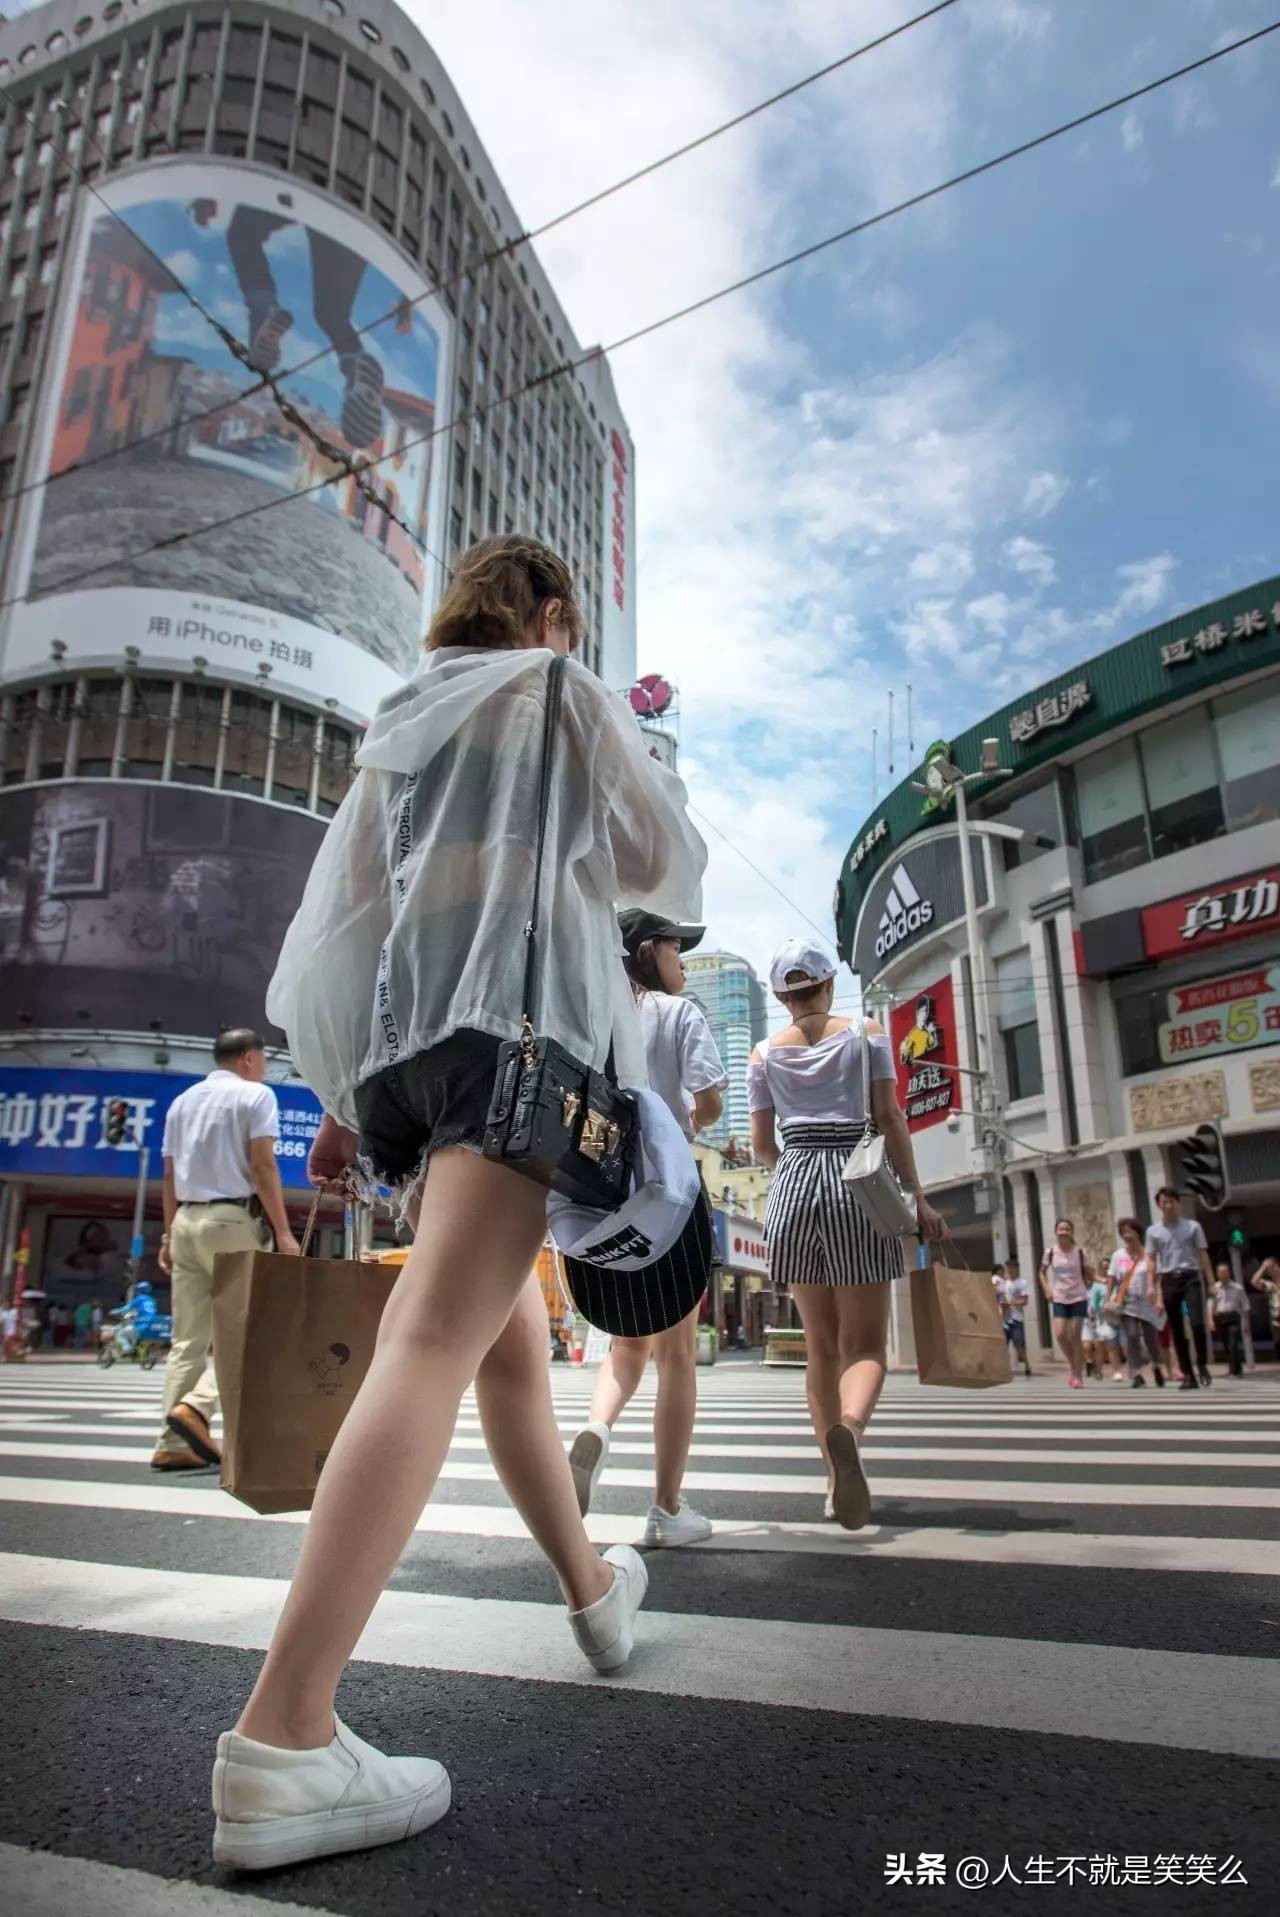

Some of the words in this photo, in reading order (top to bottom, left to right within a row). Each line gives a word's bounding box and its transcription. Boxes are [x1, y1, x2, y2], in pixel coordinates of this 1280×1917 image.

[148, 615, 171, 637] 用
[176, 619, 263, 652] iPhone
[269, 640, 312, 670] 拍摄
[1161, 601, 1280, 666] 过桥米
[875, 901, 933, 957] adidas
